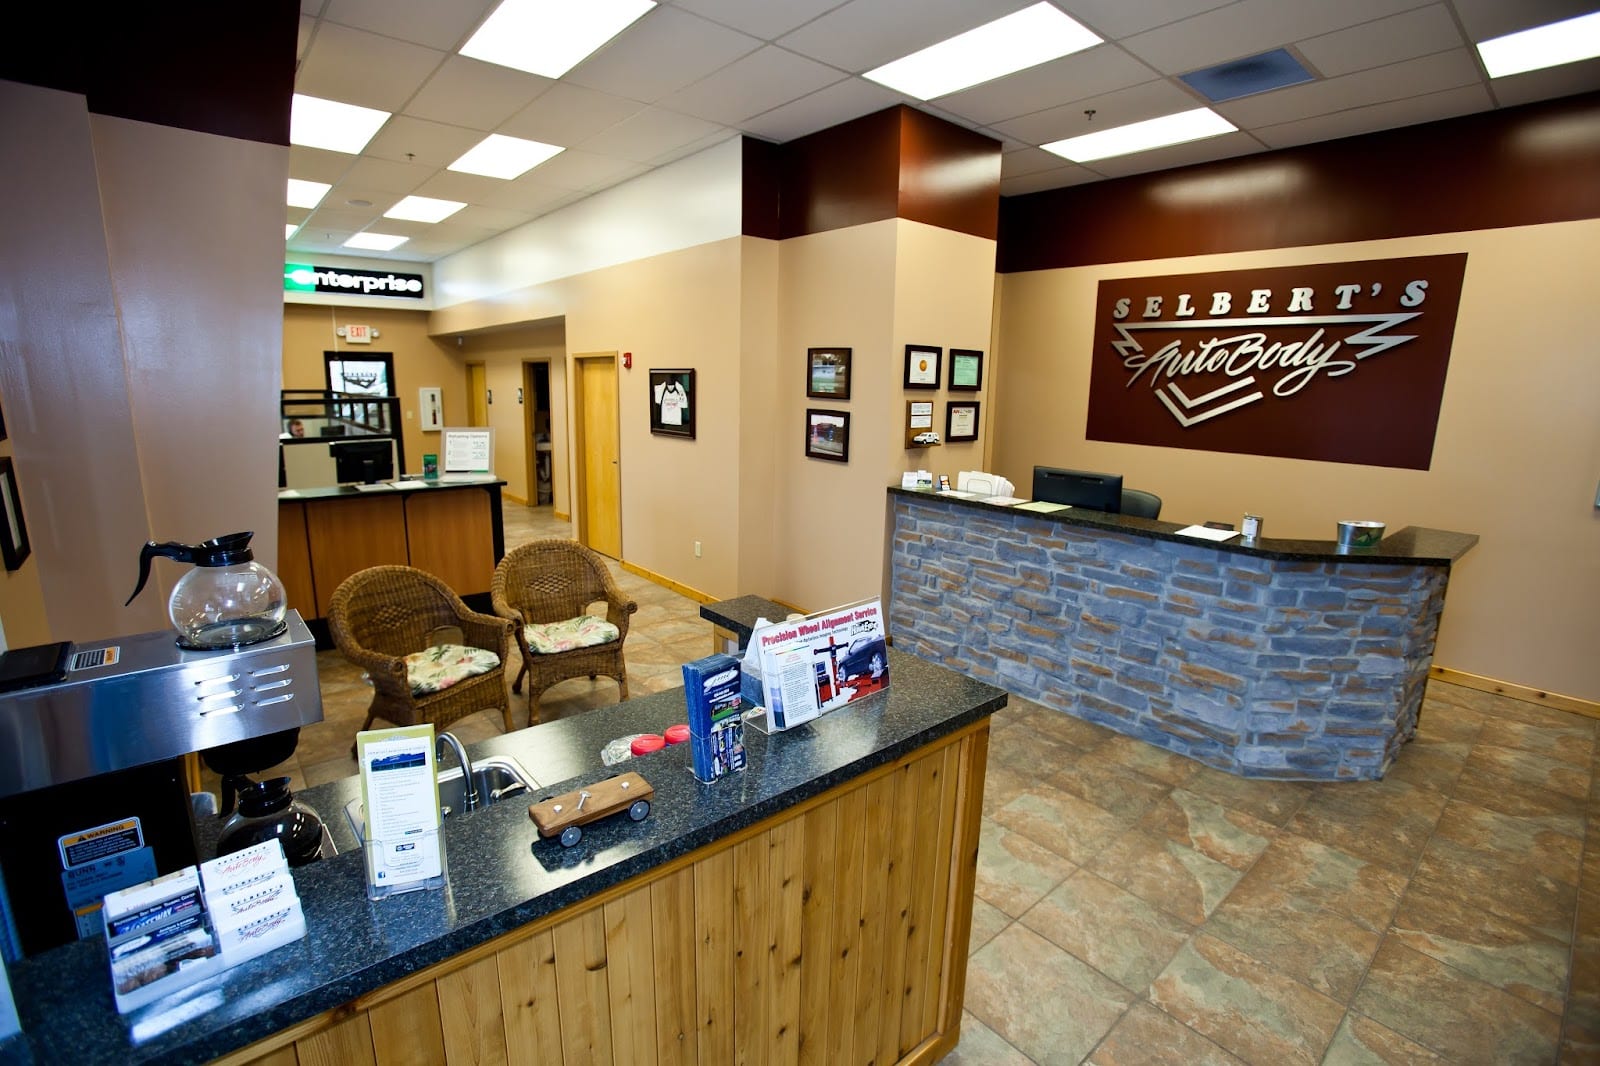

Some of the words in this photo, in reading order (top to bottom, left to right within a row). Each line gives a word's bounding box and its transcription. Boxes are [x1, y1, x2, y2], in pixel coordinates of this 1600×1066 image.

[1112, 279, 1429, 320] SELBERT'S
[350, 326, 366, 338] EXIT
[761, 629, 798, 647] Precision
[798, 622, 821, 637] Wheel
[821, 611, 856, 630] Alignment
[854, 607, 877, 620] Service
[87, 824, 125, 839] WARNING
